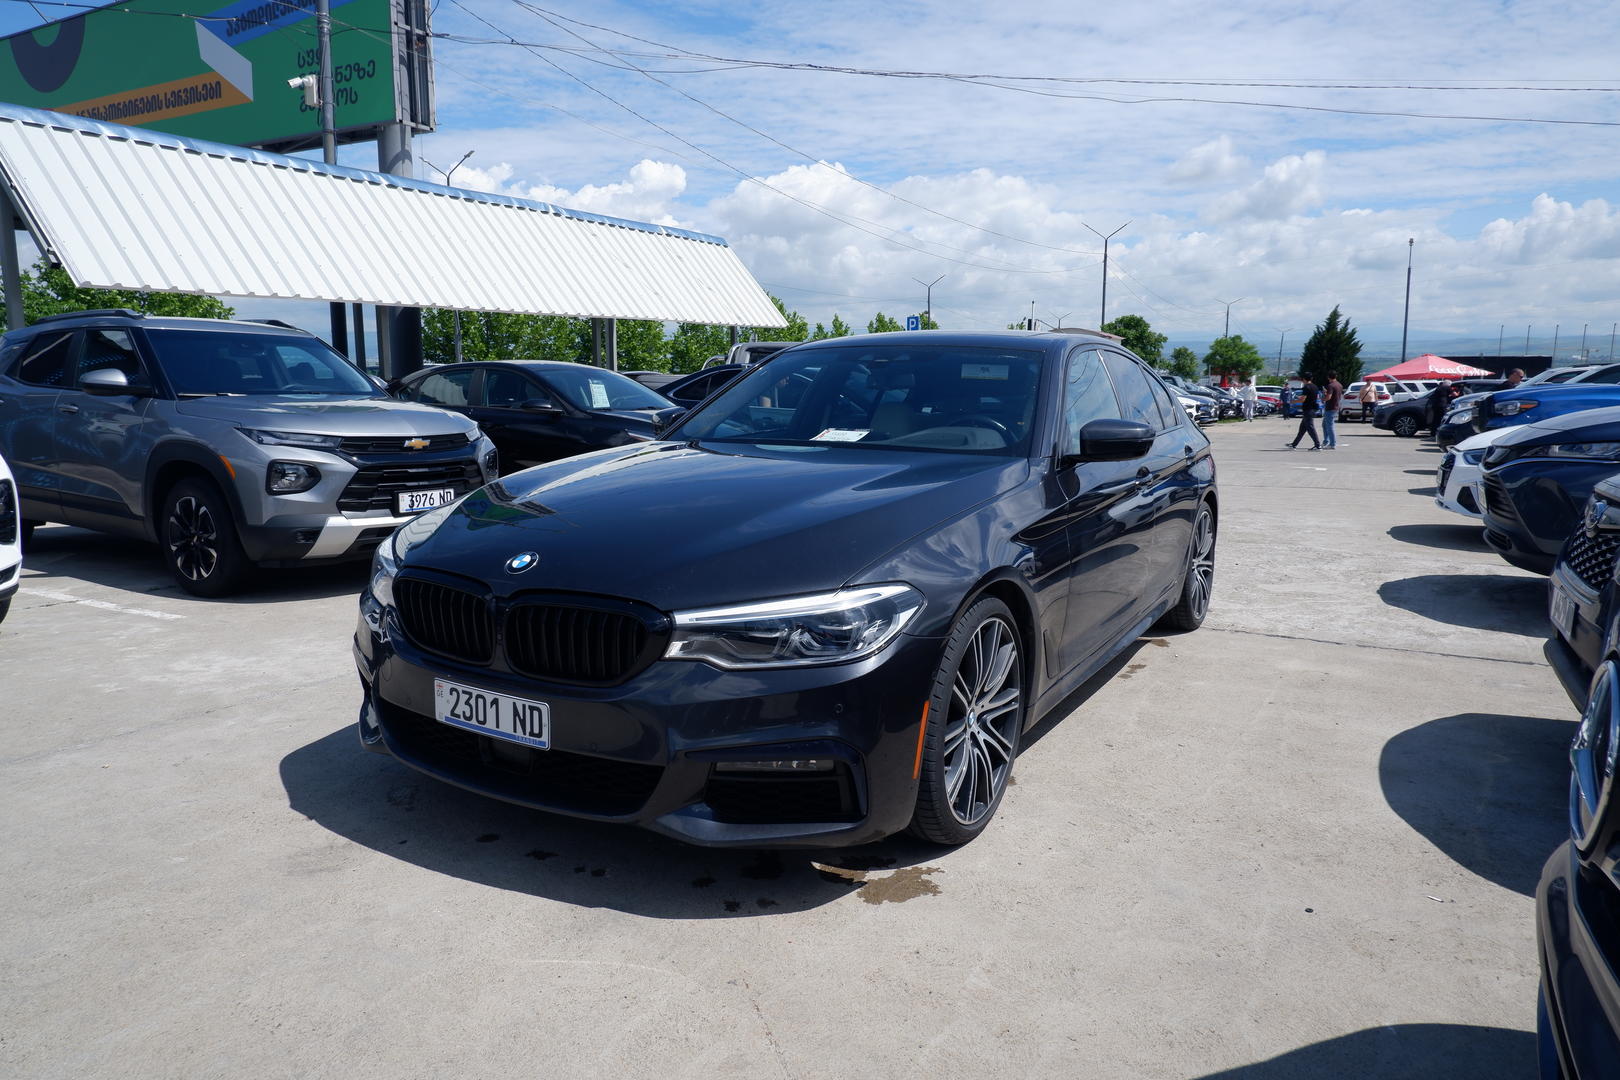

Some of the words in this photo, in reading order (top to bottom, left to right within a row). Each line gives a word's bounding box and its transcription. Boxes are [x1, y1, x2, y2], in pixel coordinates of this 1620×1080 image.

[164, 80, 222, 109] სერვისები
[910, 318, 917, 331] P
[408, 492, 435, 509] 3976
[436, 689, 444, 698] GE
[449, 686, 500, 729] 2301
[512, 701, 543, 738] ND
